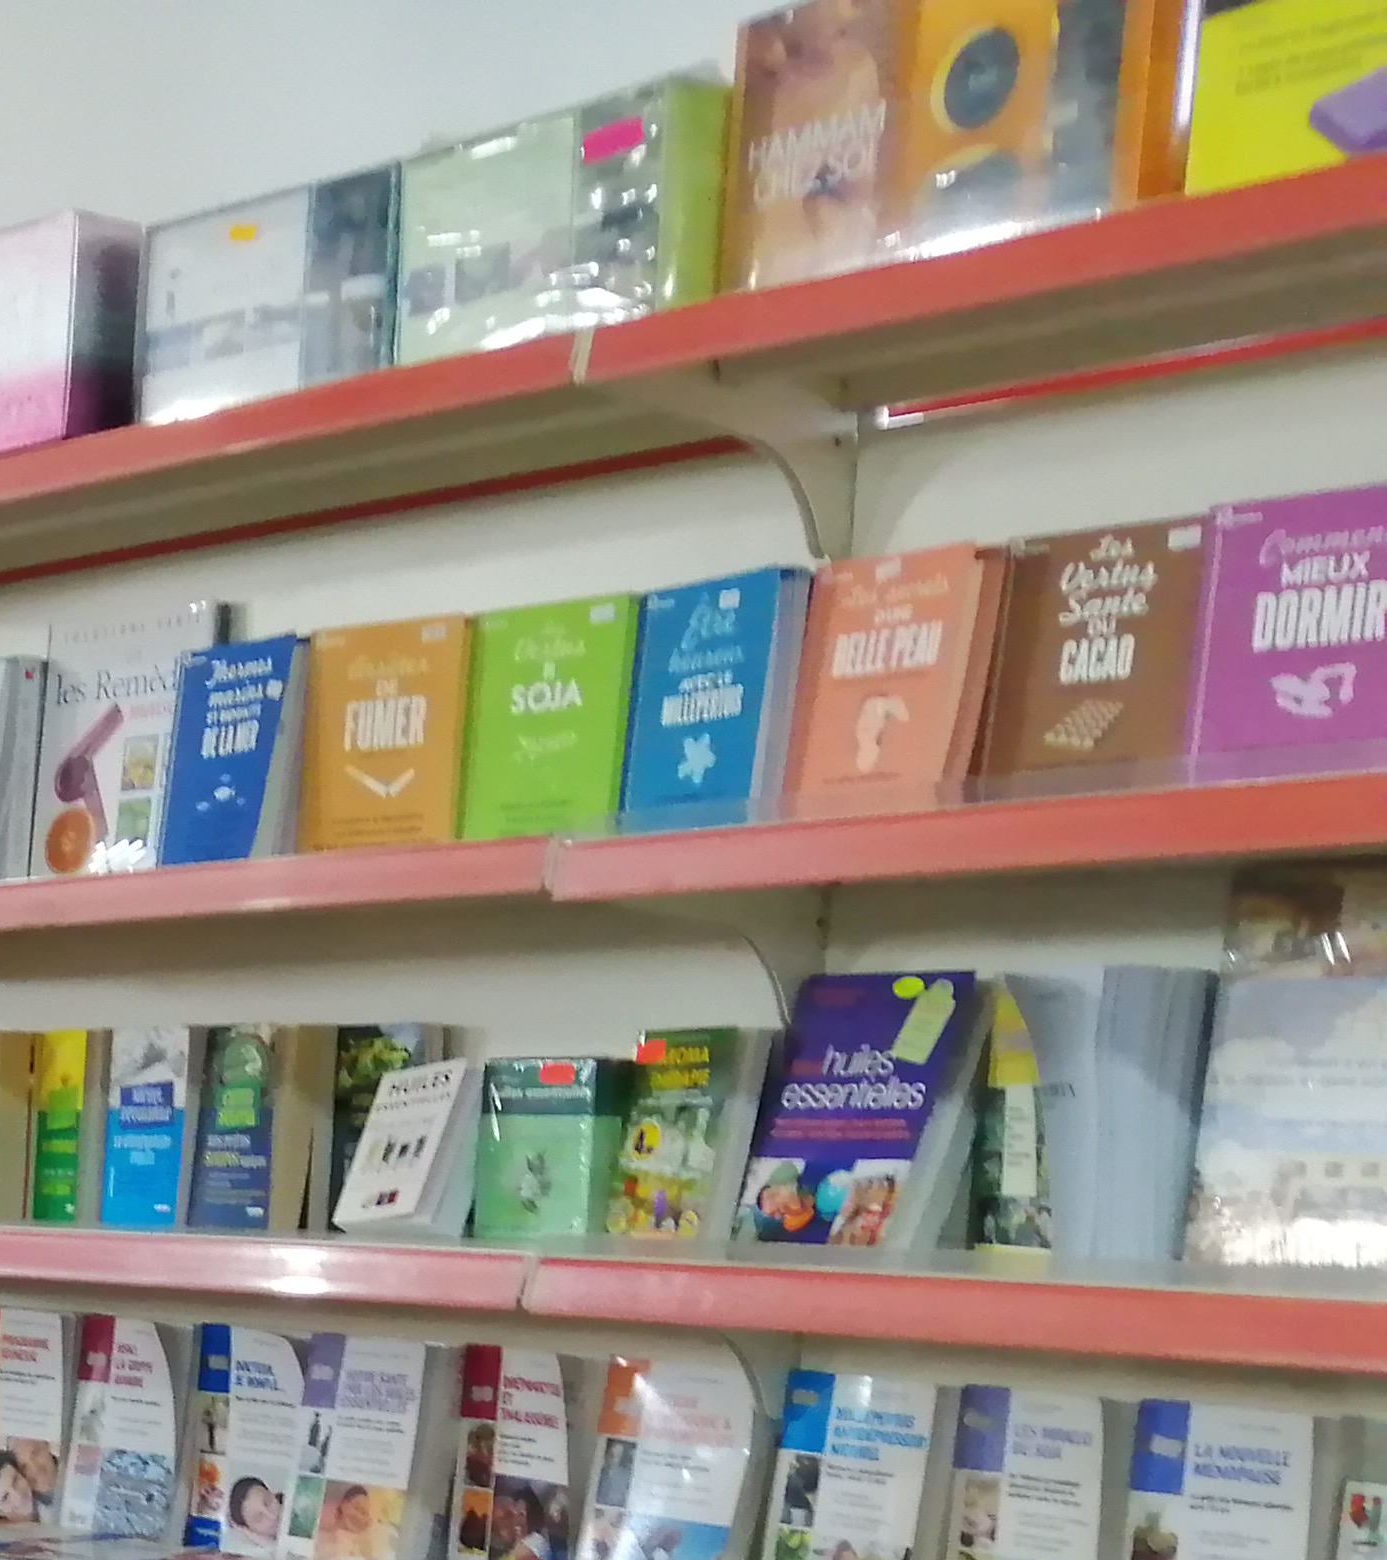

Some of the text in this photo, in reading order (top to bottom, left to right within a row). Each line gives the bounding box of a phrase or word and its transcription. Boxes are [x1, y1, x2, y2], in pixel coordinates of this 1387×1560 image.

[1281, 549, 1371, 589] MIEUX
[1058, 633, 1136, 685] CACAO
[56, 674, 87, 707] les
[510, 678, 583, 715] SOJA
[343, 694, 428, 752] FUMER
[822, 1044, 895, 1078] huiles
[780, 1074, 927, 1111] essentielles
